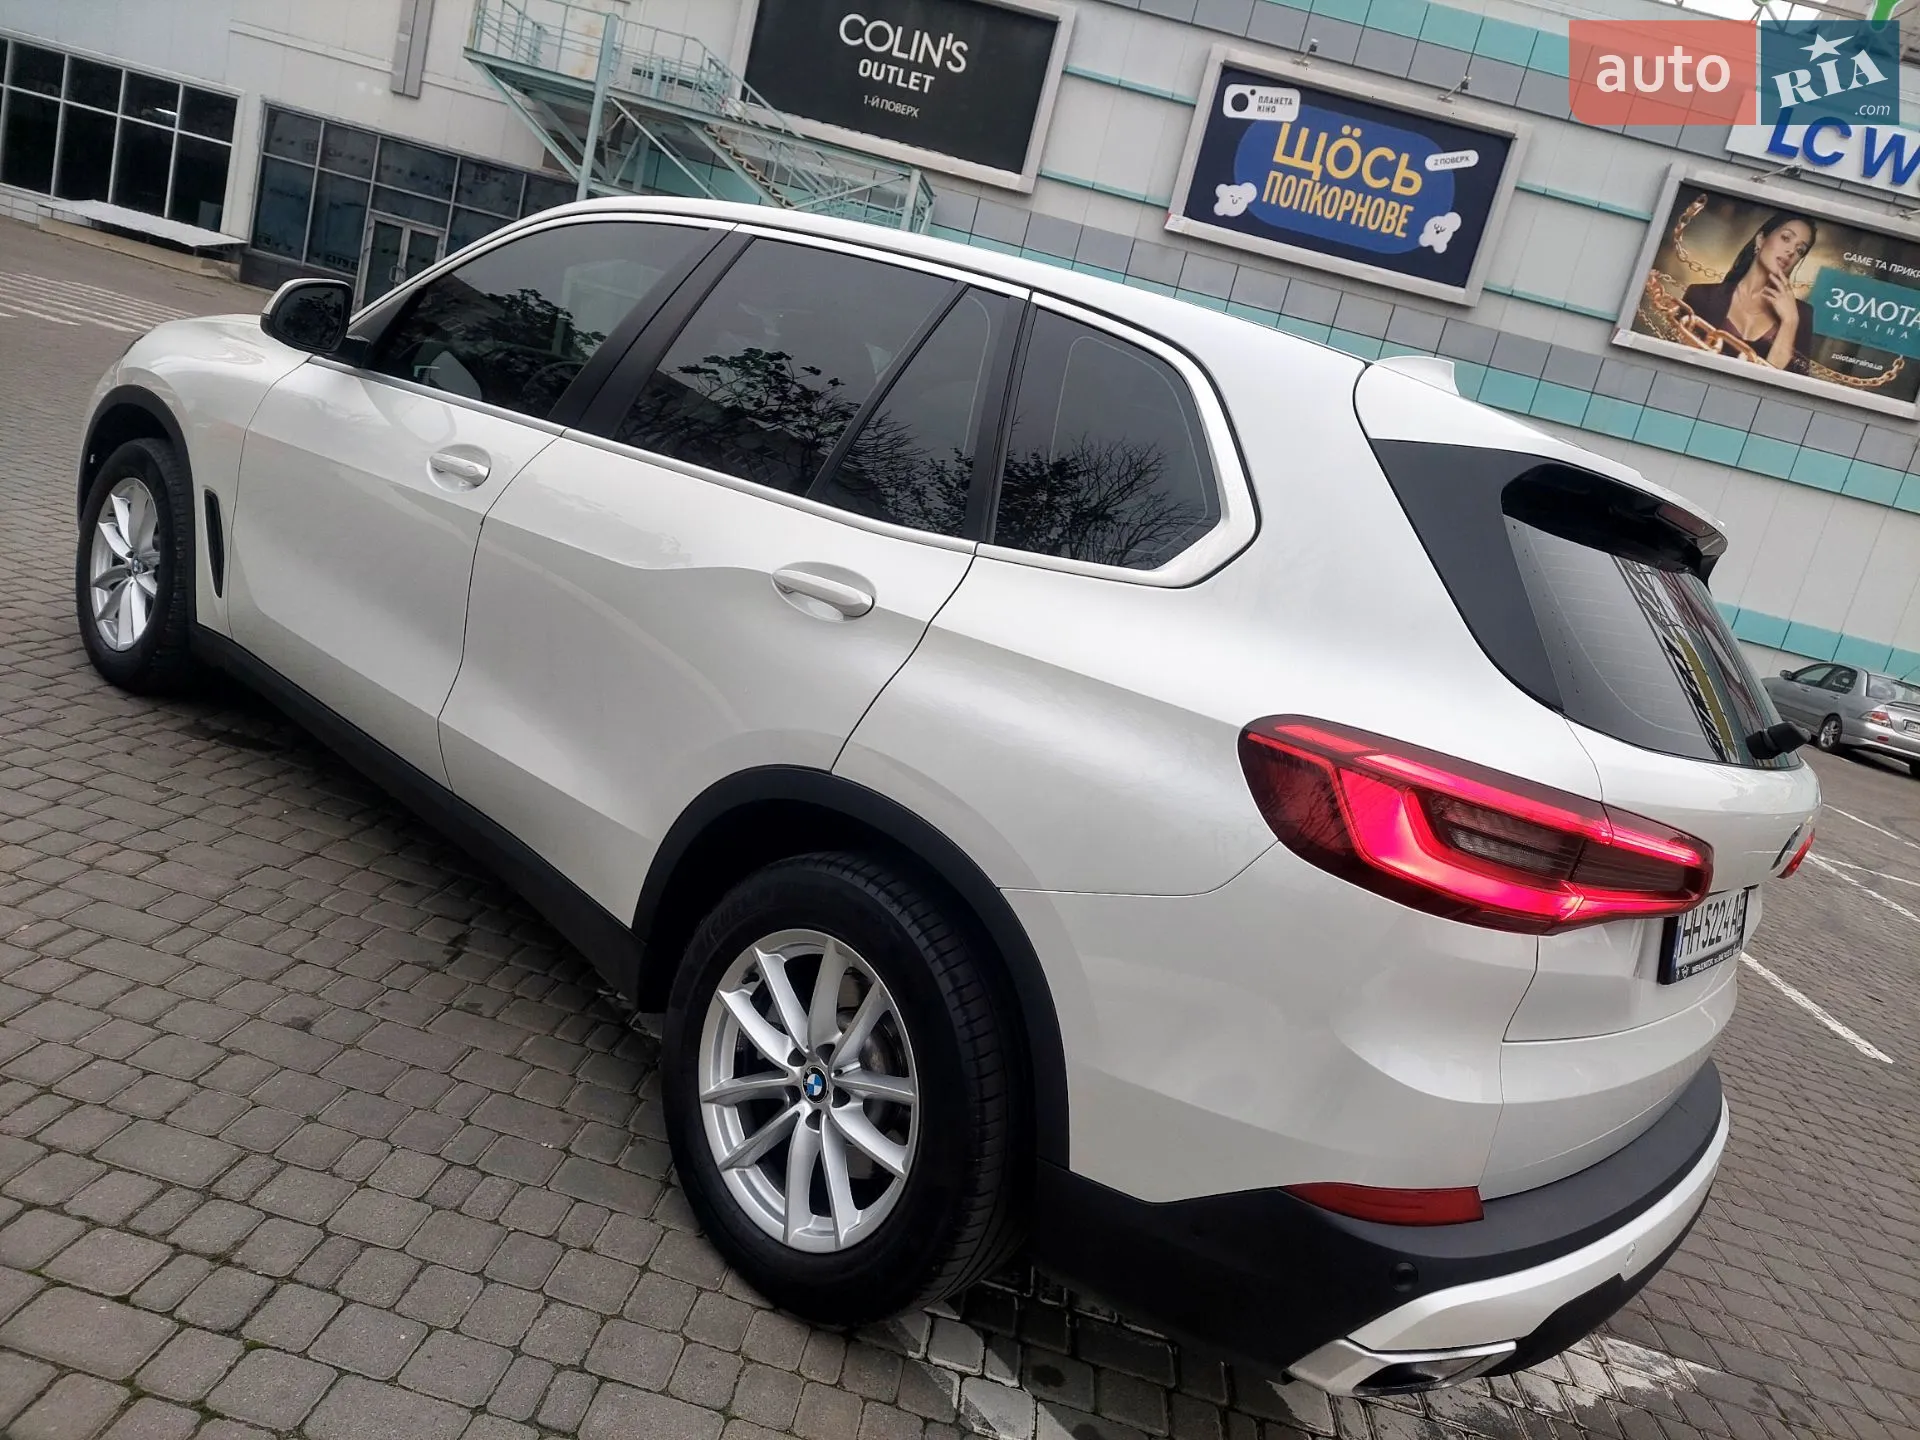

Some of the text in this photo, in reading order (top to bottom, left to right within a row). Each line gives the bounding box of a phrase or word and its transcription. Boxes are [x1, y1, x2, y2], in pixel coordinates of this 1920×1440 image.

[839, 13, 969, 73] COLIN'S
[858, 58, 936, 94] OUTLET
[880, 98, 920, 118] ПОВЕРХ
[1766, 107, 1853, 168] LC
[1440, 155, 1470, 165] ПОВЕРХ
[1262, 170, 1415, 238] ПОПКОРНОВЕ
[1843, 252, 1873, 267] САМЕ
[1875, 259, 1887, 271] ТА
